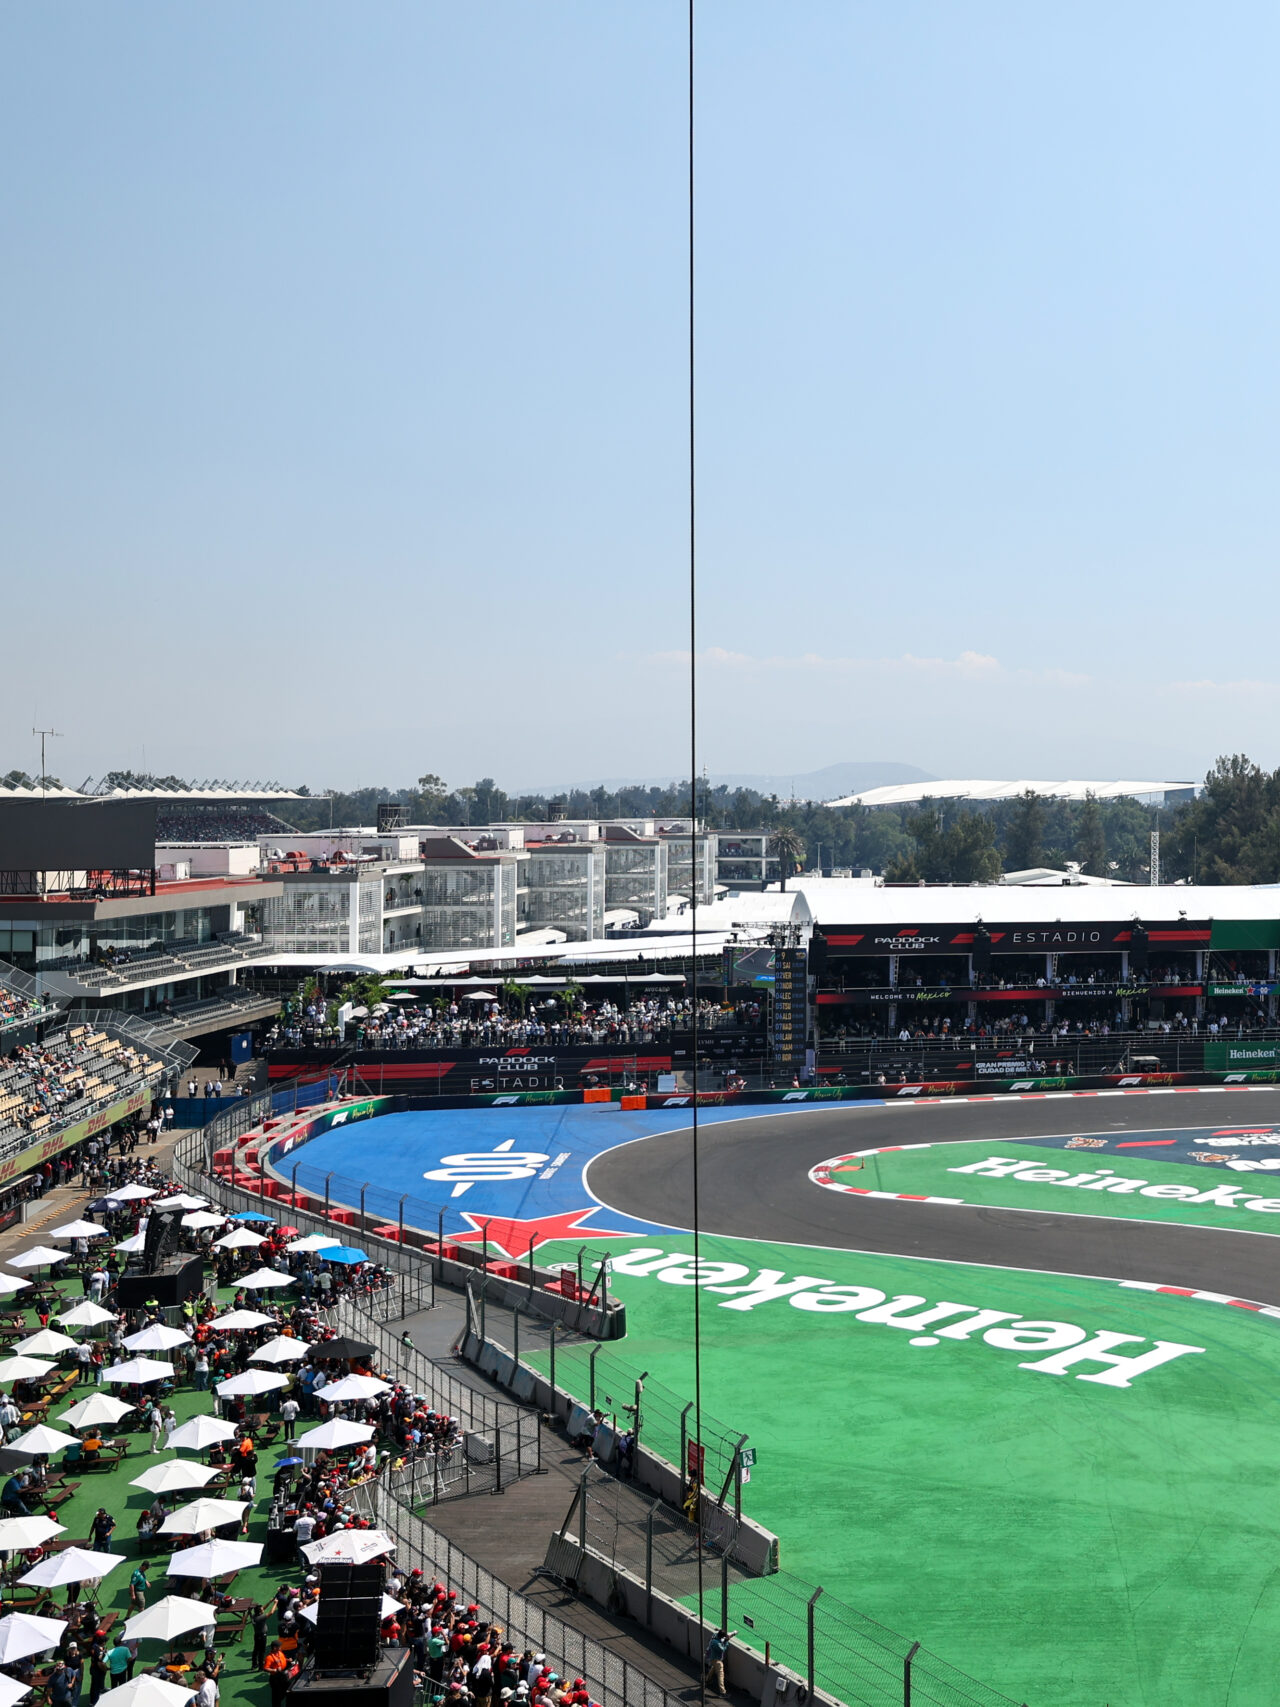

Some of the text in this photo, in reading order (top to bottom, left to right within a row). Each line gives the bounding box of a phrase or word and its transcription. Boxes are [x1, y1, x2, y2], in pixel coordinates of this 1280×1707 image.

[874, 936, 940, 944] PADDOCK
[1012, 931, 1100, 943] ESTADIO
[915, 991, 952, 1001] Mexico
[1115, 987, 1149, 997] Mexico
[1229, 1048, 1275, 1059] Heineken
[479, 1056, 556, 1064] PADDOCK
[470, 1076, 564, 1089] ESTADIO
[1117, 1076, 1142, 1086] F1
[1223, 1074, 1248, 1082] F1
[897, 1086, 923, 1095] F1
[1009, 1082, 1035, 1090] F1
[492, 1096, 520, 1105] F1
[782, 1091, 809, 1100] F1
[662, 1096, 690, 1106] F1
[331, 1111, 349, 1126] F1
[592, 1248, 1206, 1388] Heineken
